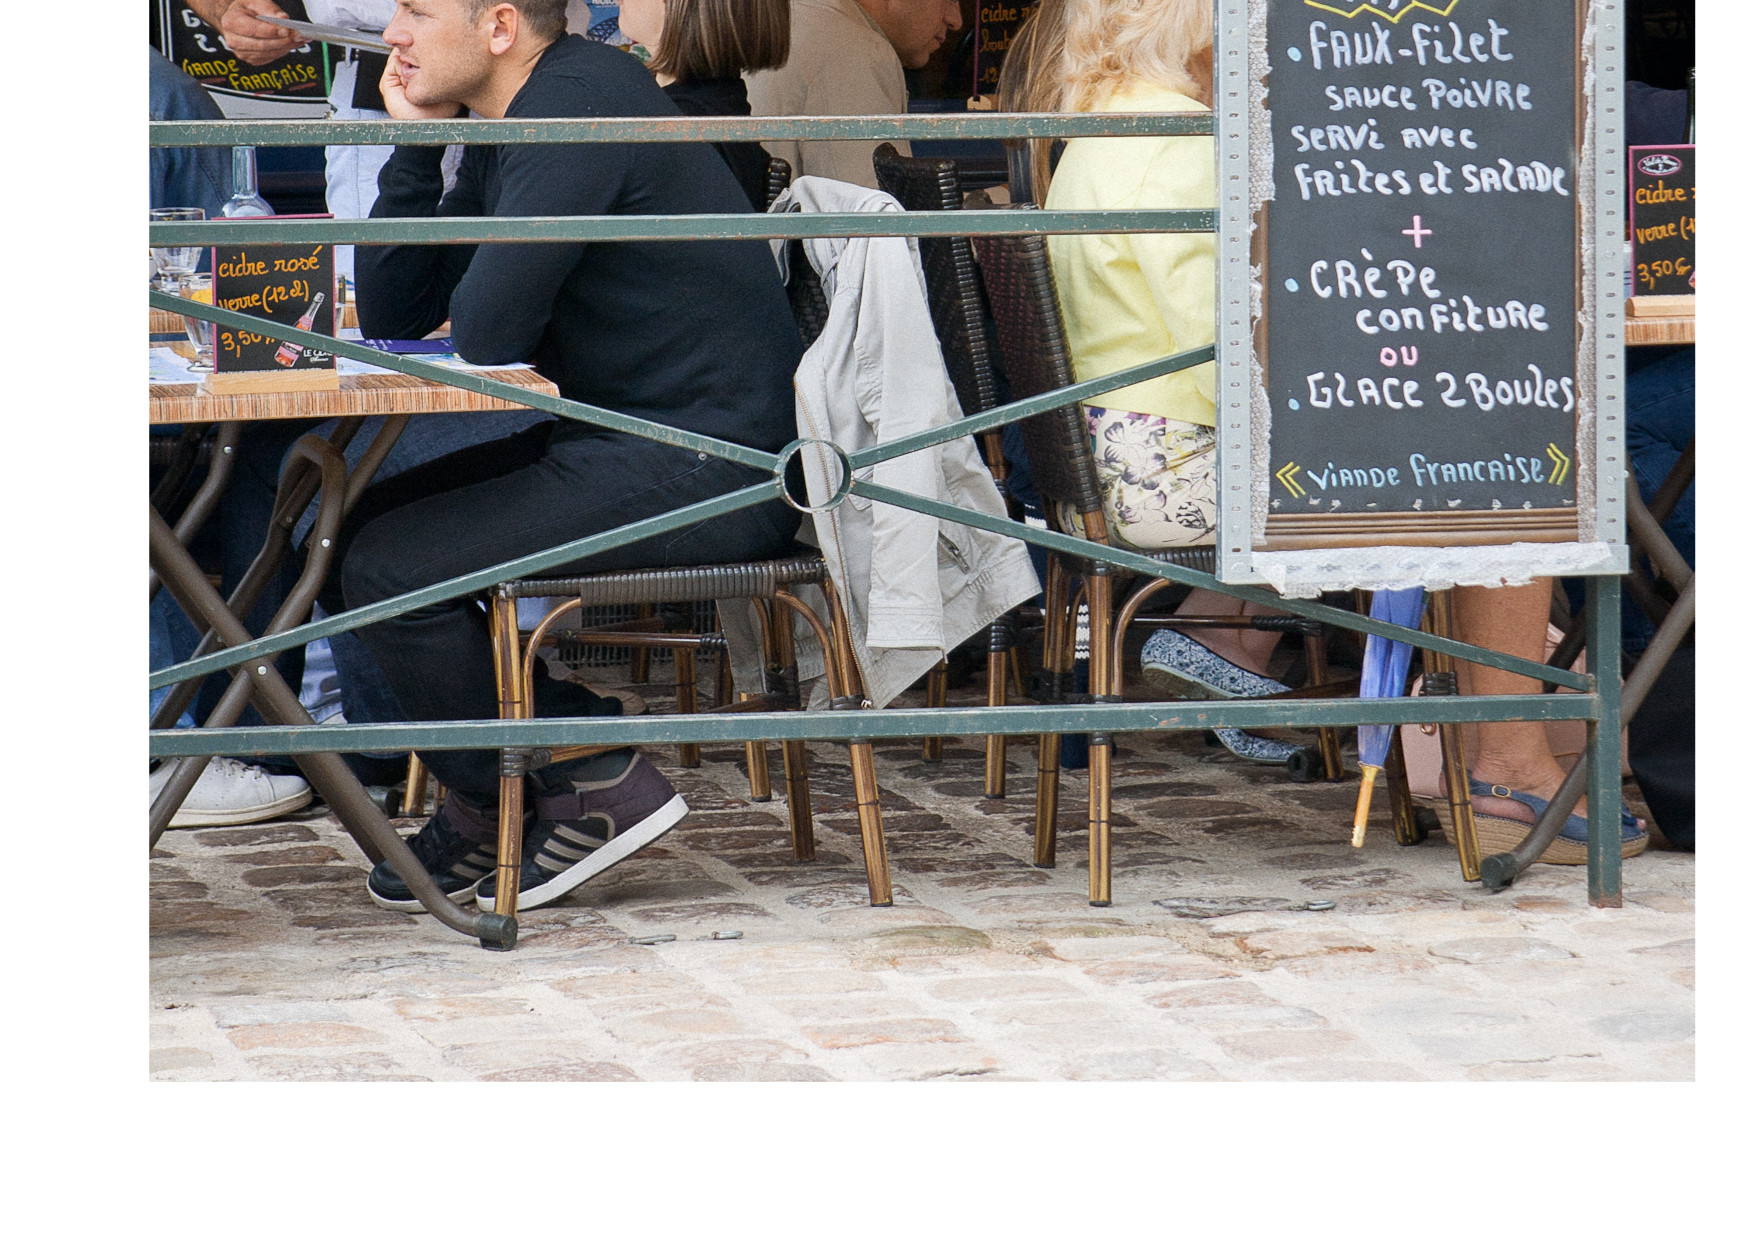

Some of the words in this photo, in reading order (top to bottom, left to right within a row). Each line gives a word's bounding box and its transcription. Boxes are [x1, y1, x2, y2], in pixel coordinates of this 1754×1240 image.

[1635, 179, 1688, 205] cidre
[1401, 214, 1433, 249] +
[1636, 221, 1677, 245] verre
[218, 252, 269, 278] cidre
[273, 245, 323, 272] rosé
[1435, 371, 1467, 409] 2
